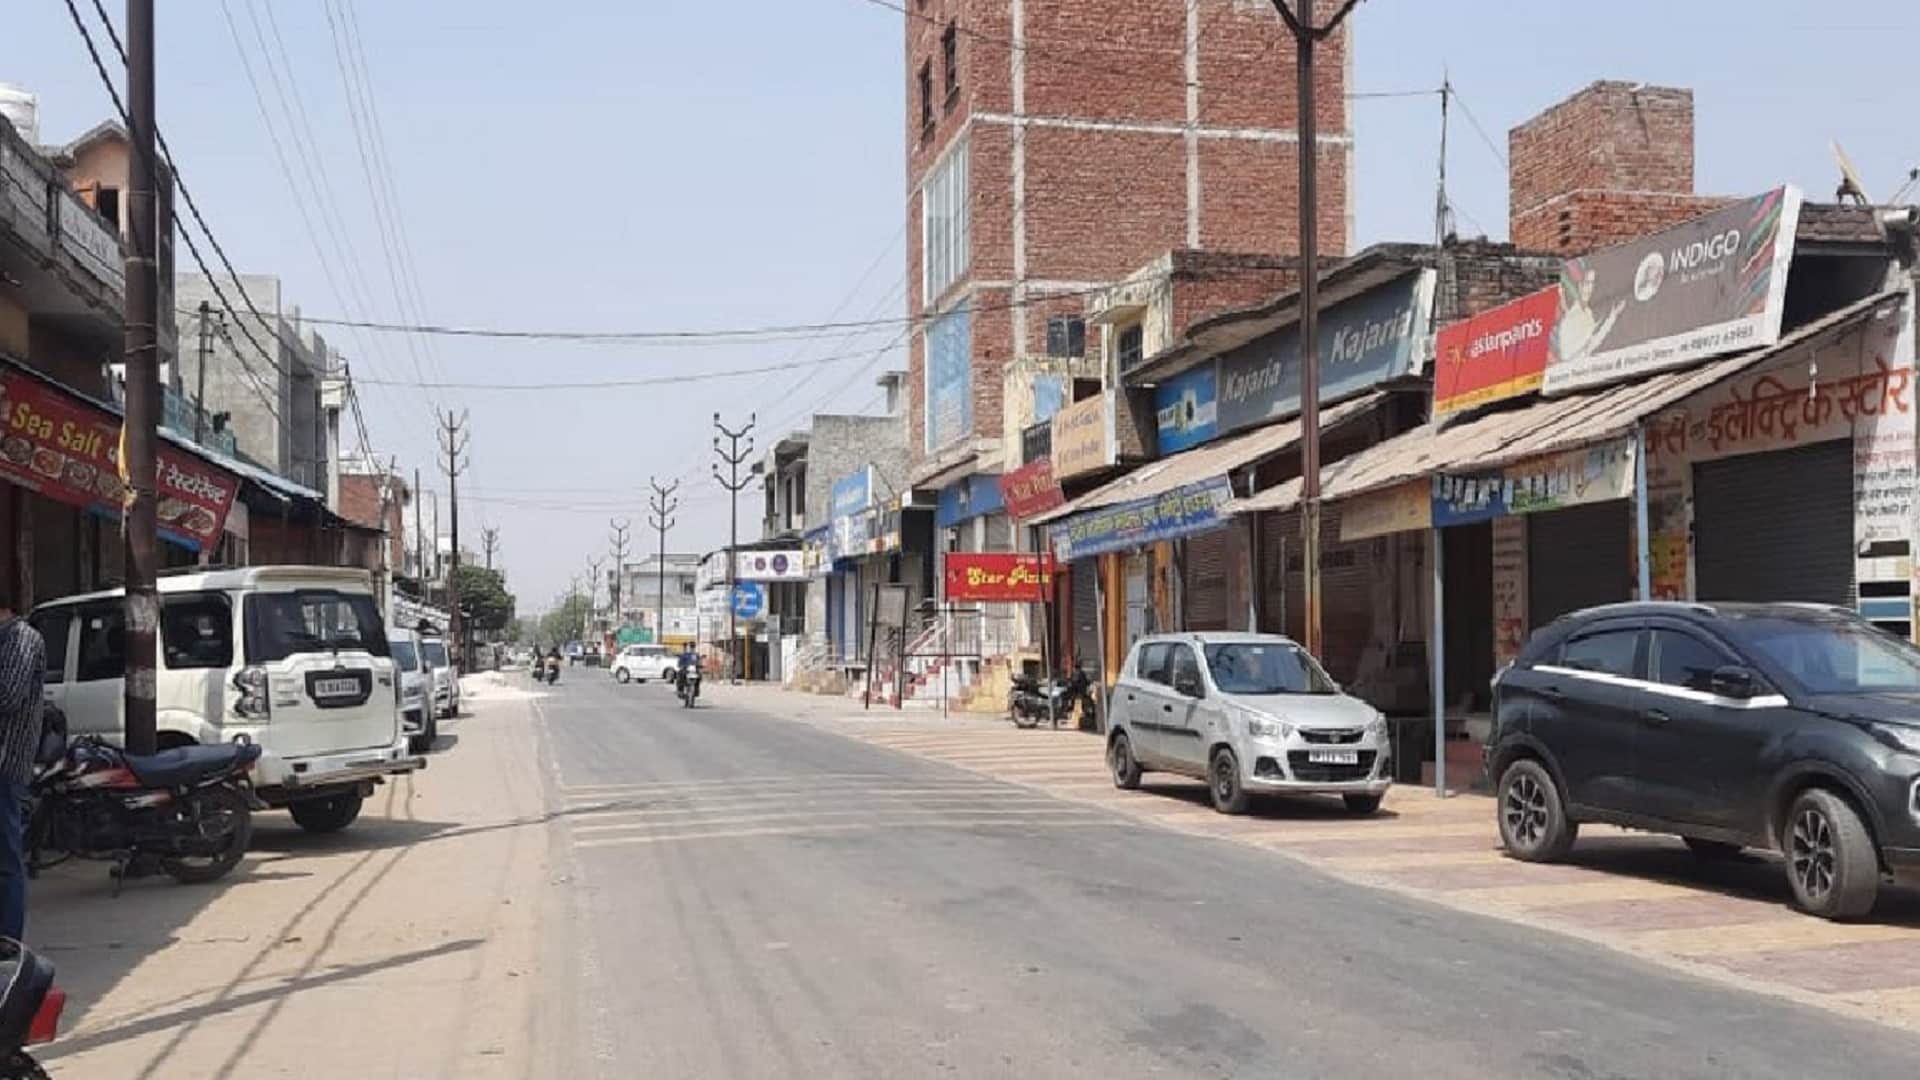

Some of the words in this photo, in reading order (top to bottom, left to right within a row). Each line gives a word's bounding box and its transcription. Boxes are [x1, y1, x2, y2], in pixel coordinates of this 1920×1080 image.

[1669, 229, 1740, 273] INDIGO
[1330, 308, 1413, 364] Kajaria
[1470, 318, 1543, 360] asianpaints
[1223, 358, 1283, 403] Kajaria
[1838, 353, 1915, 424] स्टोर
[11, 402, 54, 439] Sea
[58, 421, 101, 458] Salt
[967, 566, 1005, 587] Star
